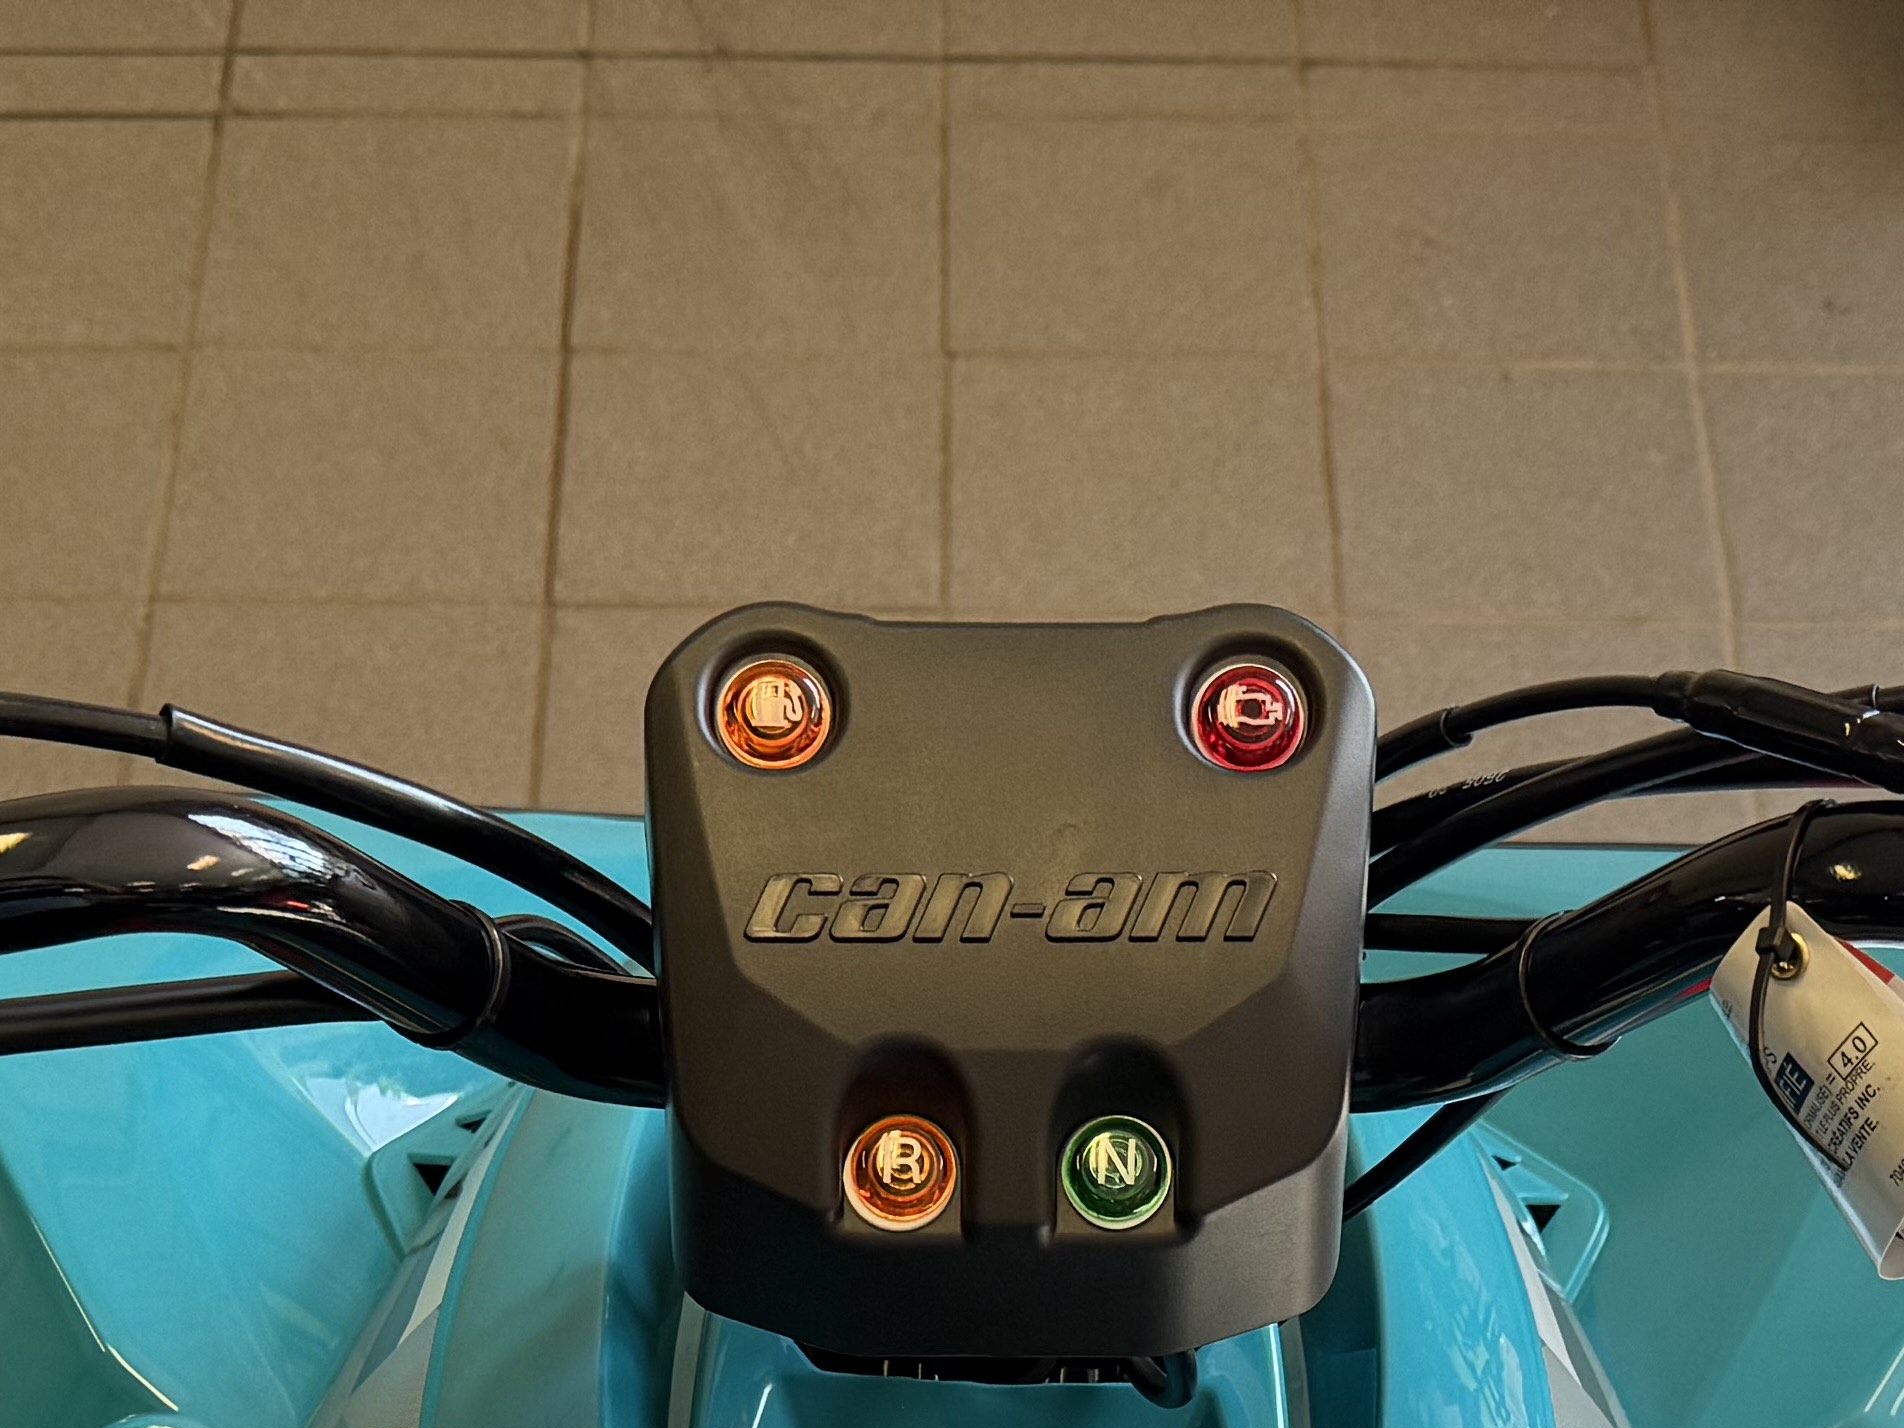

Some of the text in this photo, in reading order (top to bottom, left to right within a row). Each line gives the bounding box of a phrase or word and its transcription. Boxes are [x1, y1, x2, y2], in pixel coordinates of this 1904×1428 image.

[743, 871, 1278, 943] can-am
[1839, 1034, 1868, 1069] 4.0
[1833, 1057, 1877, 1107] PROPRE.
[1853, 1082, 1882, 1112] INC.
[880, 1130, 923, 1184] R
[1095, 1135, 1138, 1186] N
[1846, 1115, 1880, 1156] VENTE.
